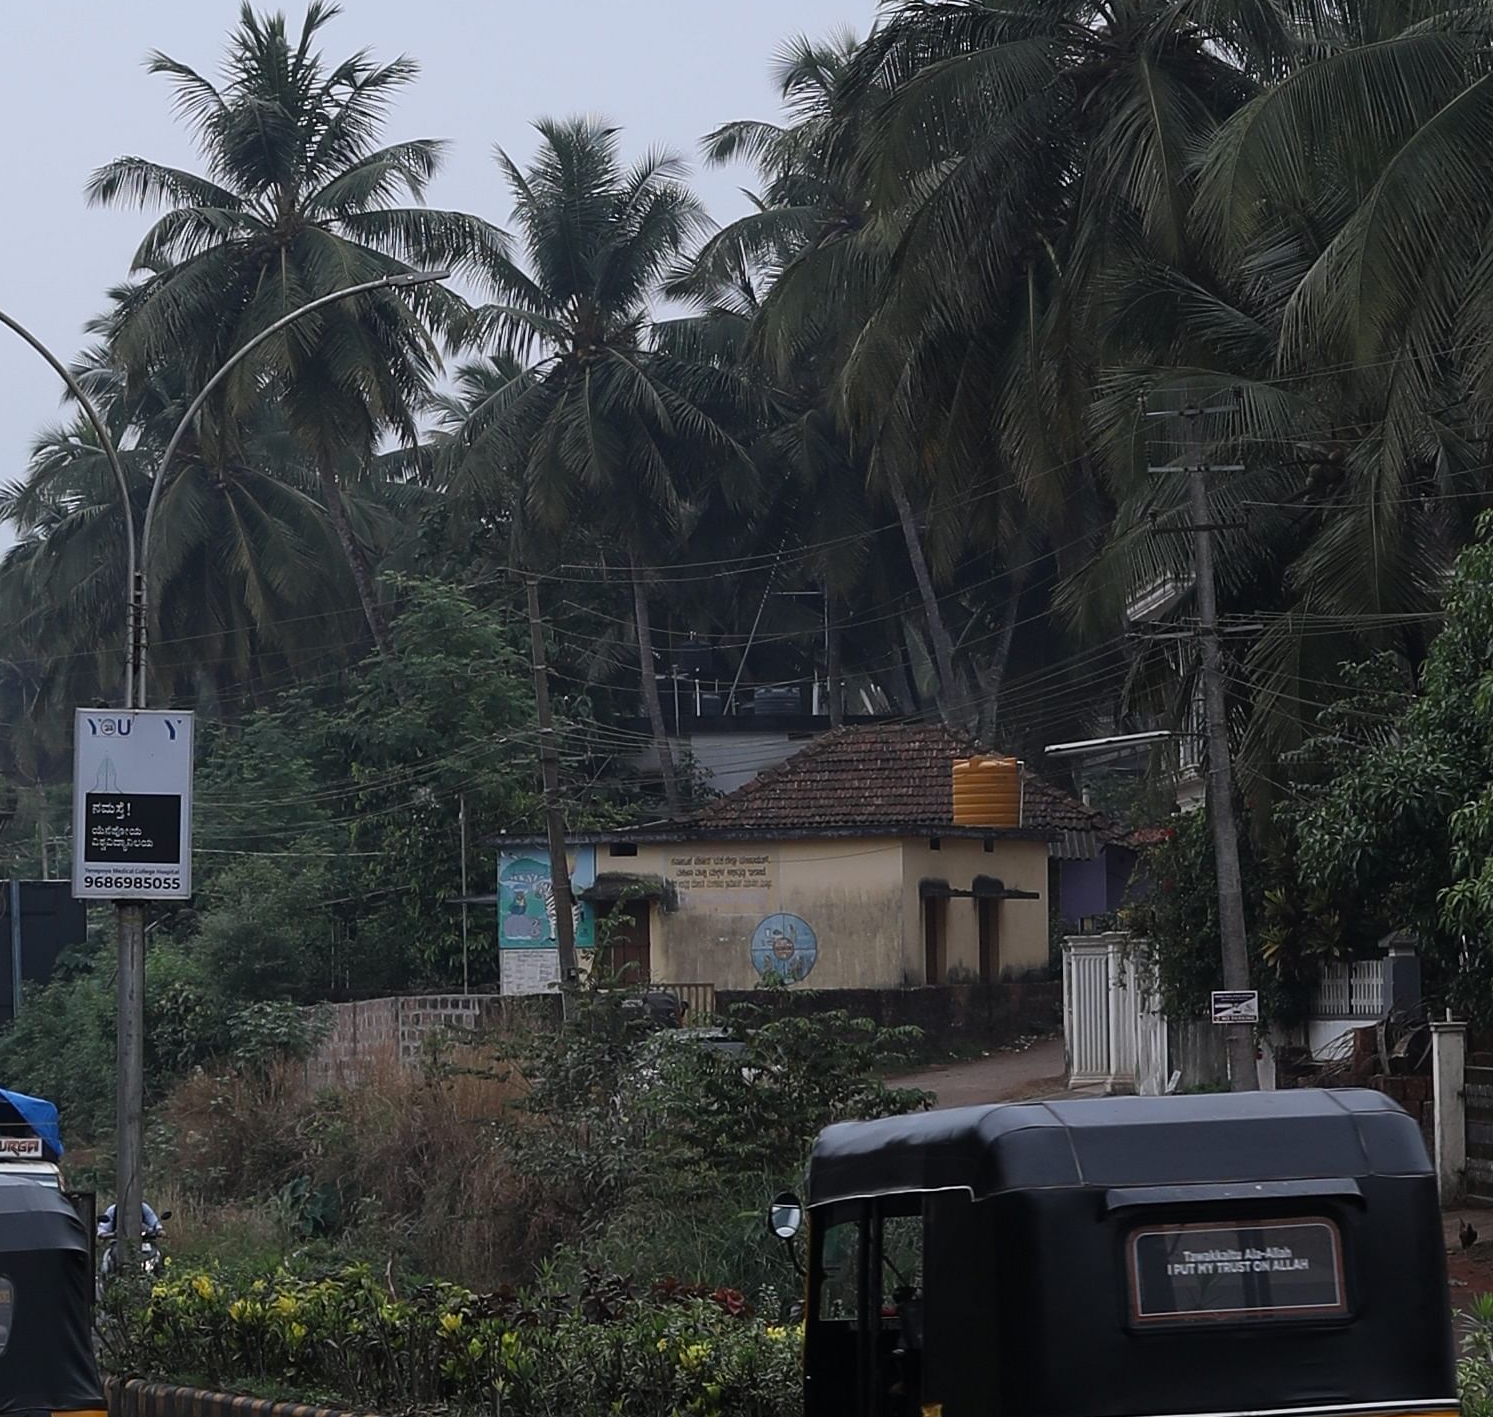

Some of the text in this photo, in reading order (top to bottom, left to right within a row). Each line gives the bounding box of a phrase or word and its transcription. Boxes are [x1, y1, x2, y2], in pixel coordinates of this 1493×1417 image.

[84, 876, 181, 889] 9686985055
[1167, 1259, 1309, 1275] I PUT MY TRUST ON ALLAH
